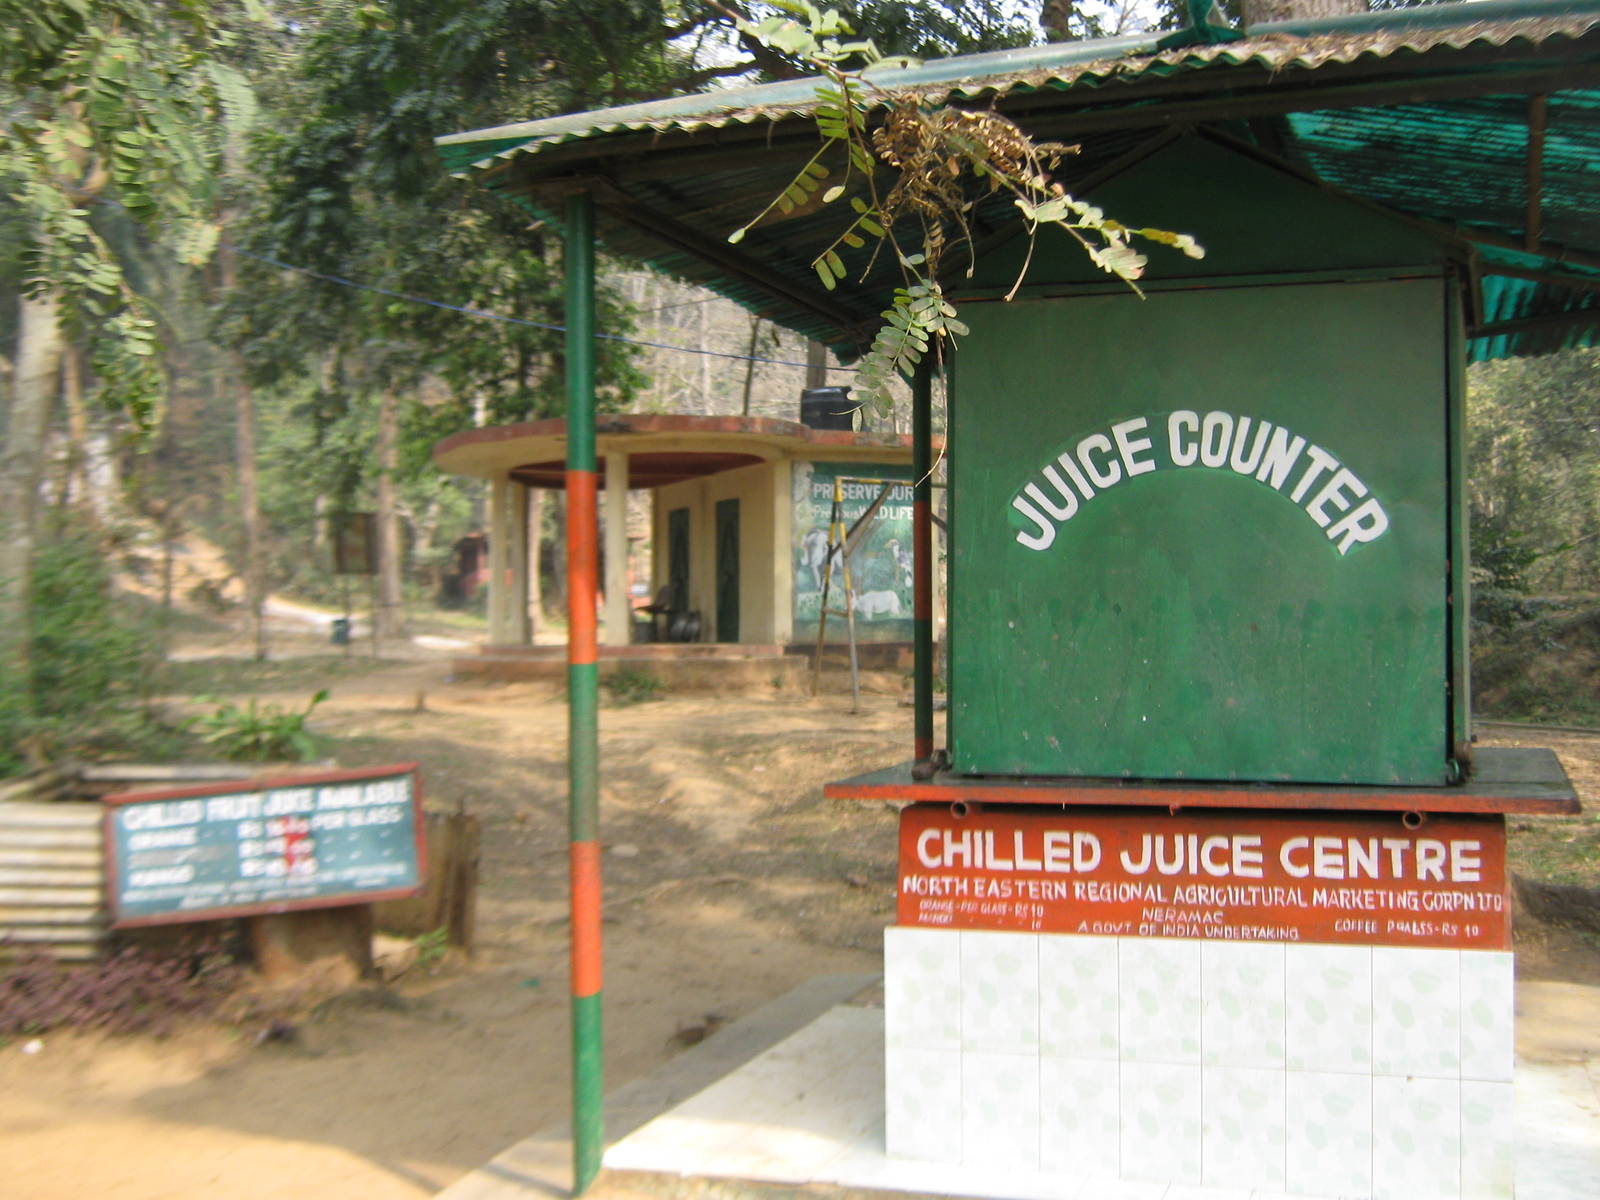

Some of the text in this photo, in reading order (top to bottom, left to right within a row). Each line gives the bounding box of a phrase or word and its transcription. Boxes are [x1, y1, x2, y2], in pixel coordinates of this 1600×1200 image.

[1012, 409, 1390, 557] JUICE COUNTER
[916, 828, 1482, 883] CHILLED JUICE CENTRE
[902, 874, 969, 898] NORTH
[973, 876, 1068, 901] EASTERN
[1072, 879, 1168, 904] REGIONAL
[1173, 883, 1308, 908] AGRICULTURAL
[1312, 887, 1419, 912] MARKETING
[1476, 890, 1503, 912] LTD
[1031, 903, 1044, 918] 10
[1141, 907, 1224, 925] NERAMAC
[1077, 920, 1300, 941] A GOVT OF INDIA UNDERTAKING
